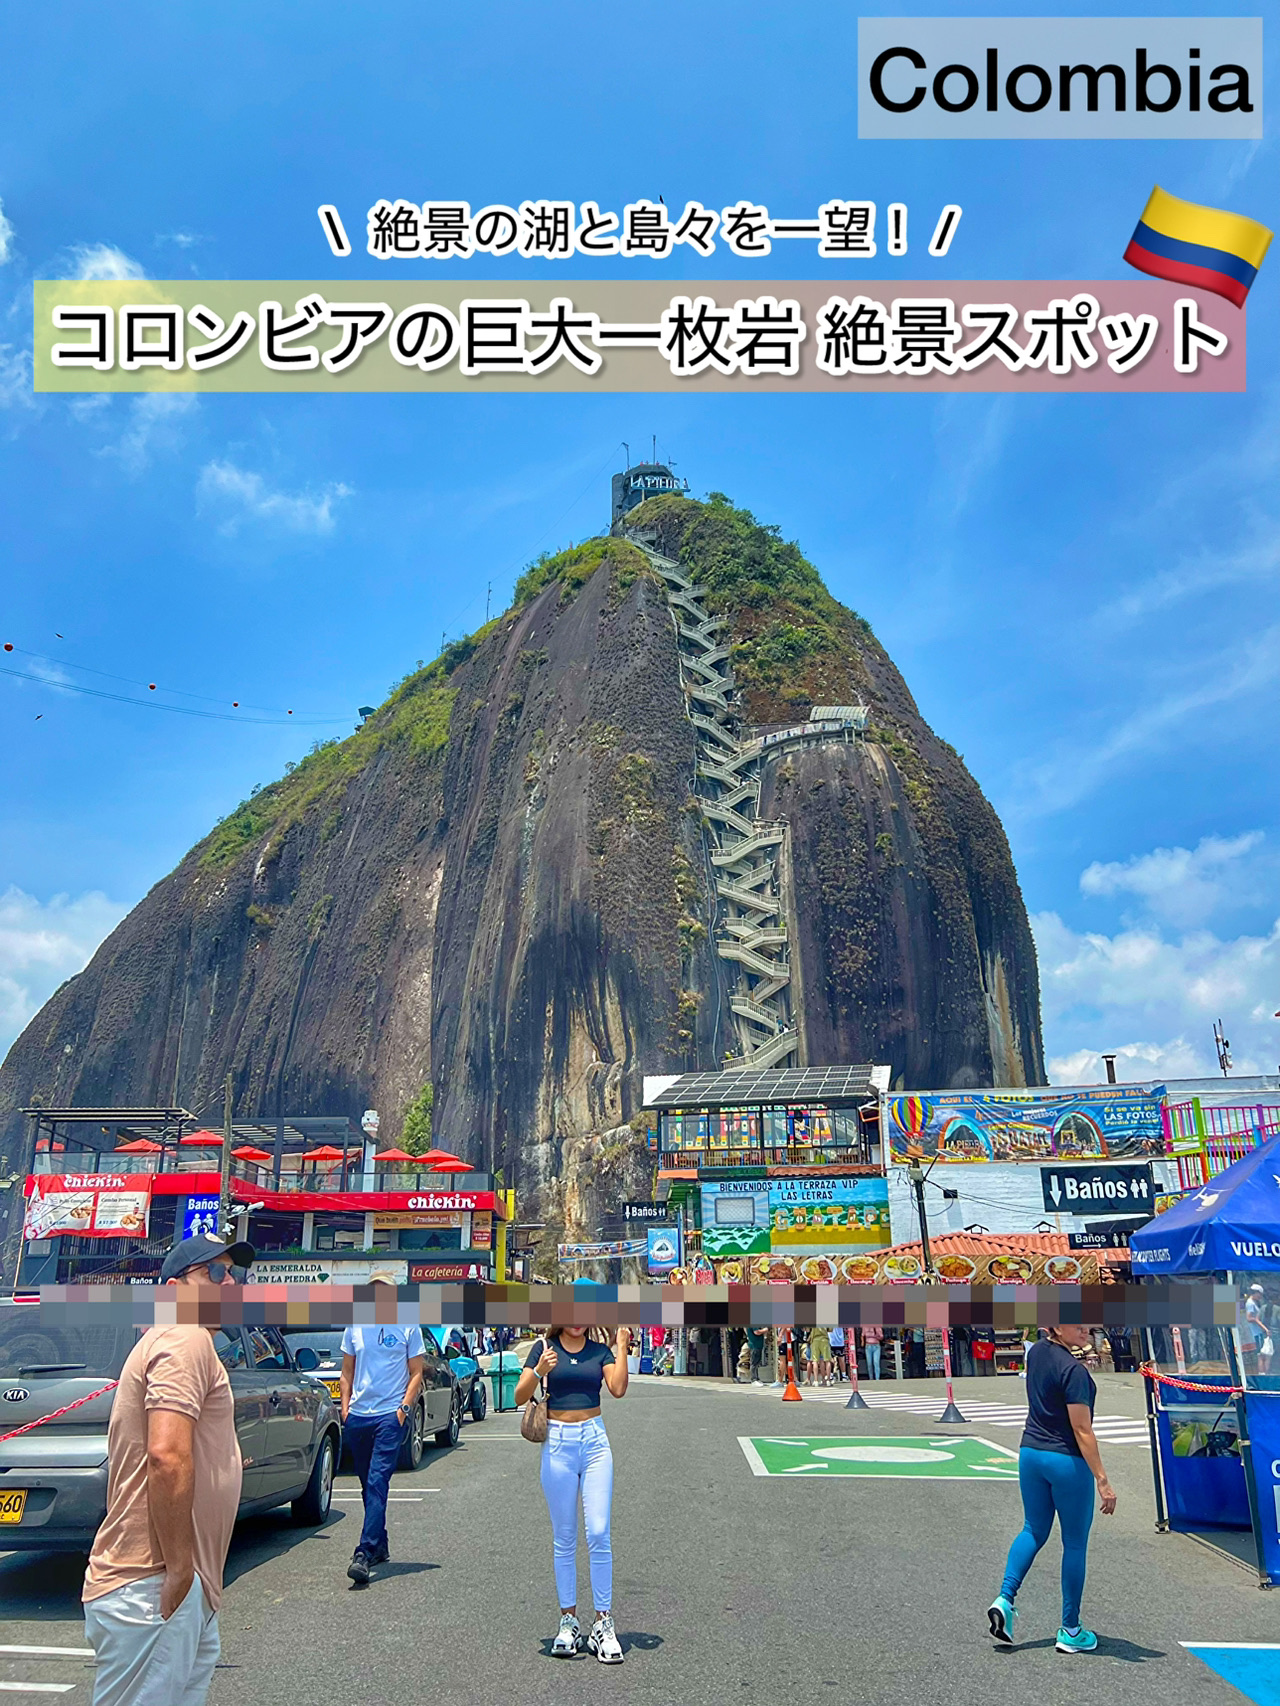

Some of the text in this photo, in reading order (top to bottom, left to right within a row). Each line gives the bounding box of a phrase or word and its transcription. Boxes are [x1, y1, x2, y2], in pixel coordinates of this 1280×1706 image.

[1104, 1112, 1123, 1120] LAS
[720, 1180, 858, 1191] BIENVENIDOS A LA TERRAZA VIP
[1064, 1177, 1128, 1199] Baños
[781, 1191, 833, 1200] LAS LETRAS
[188, 1198, 219, 1210] Baños
[631, 1206, 657, 1217] Baños
[1075, 1233, 1107, 1243] Baños
[257, 1264, 322, 1273] LA ESMERALDA
[412, 1265, 463, 1279] La cafetería
[130, 1277, 153, 1285] Baños
[258, 1275, 317, 1283] EN LA PIEDRA
[6, 1390, 24, 1400] KIA
